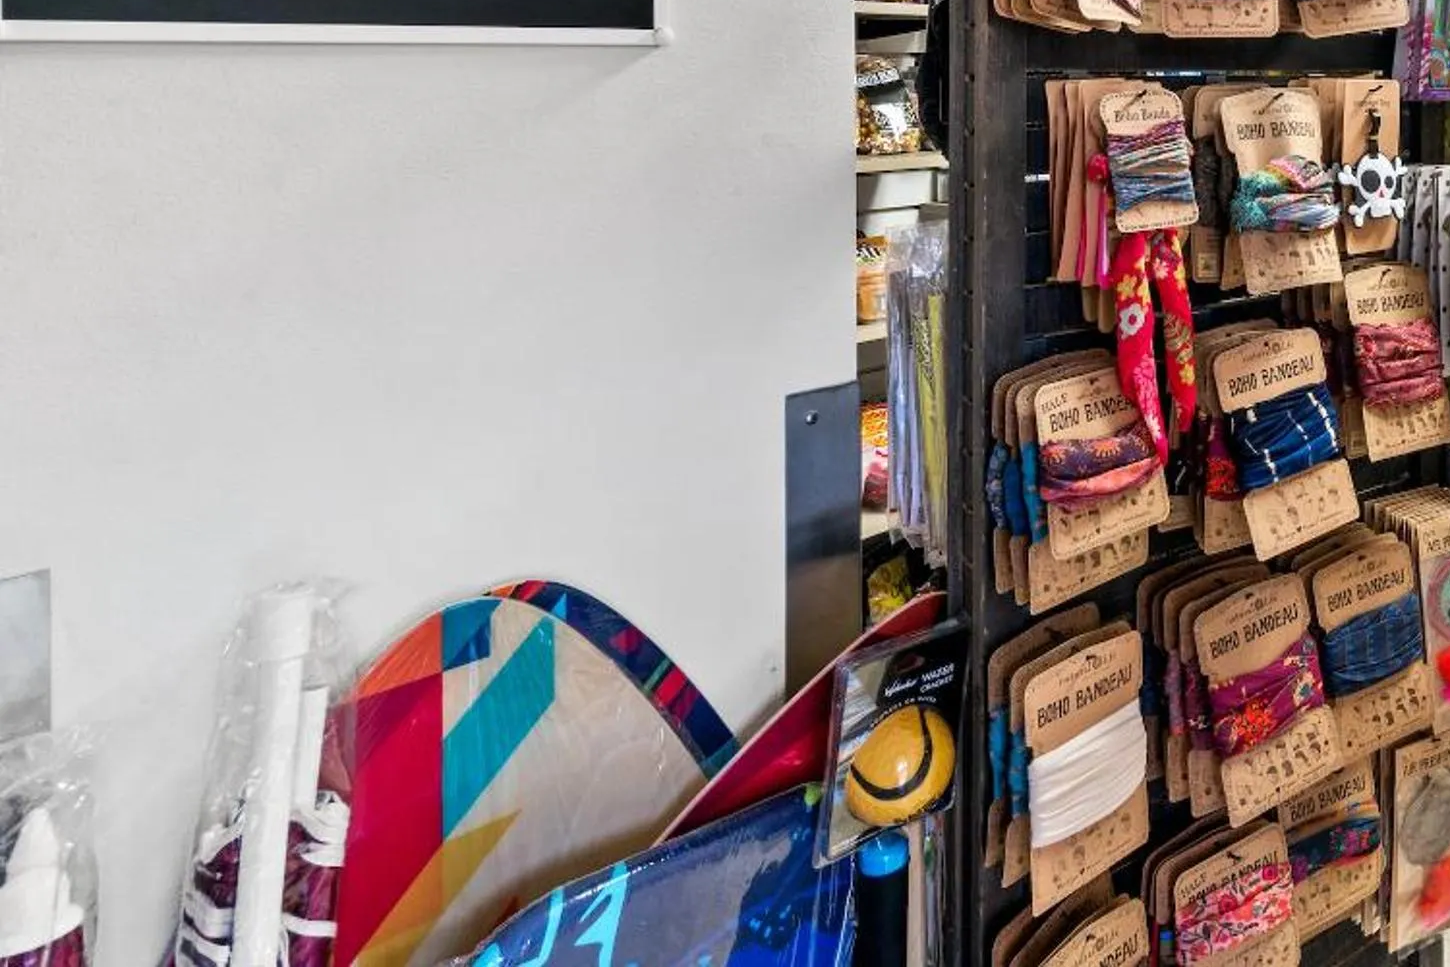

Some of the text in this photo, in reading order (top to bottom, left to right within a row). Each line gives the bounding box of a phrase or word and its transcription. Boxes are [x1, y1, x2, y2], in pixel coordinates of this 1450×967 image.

[1228, 355, 1315, 398] BOHO BANDEAU
[1050, 395, 1134, 433] BOHO BANDEA
[1326, 571, 1405, 612] BOHO BANDEAU
[1209, 605, 1299, 659] BOHO BANDEAU
[1036, 696, 1071, 729] BOHO
[1075, 664, 1133, 710] BANDEAU
[1290, 800, 1317, 823] BOHO
[1319, 777, 1367, 811] BANDEAU
